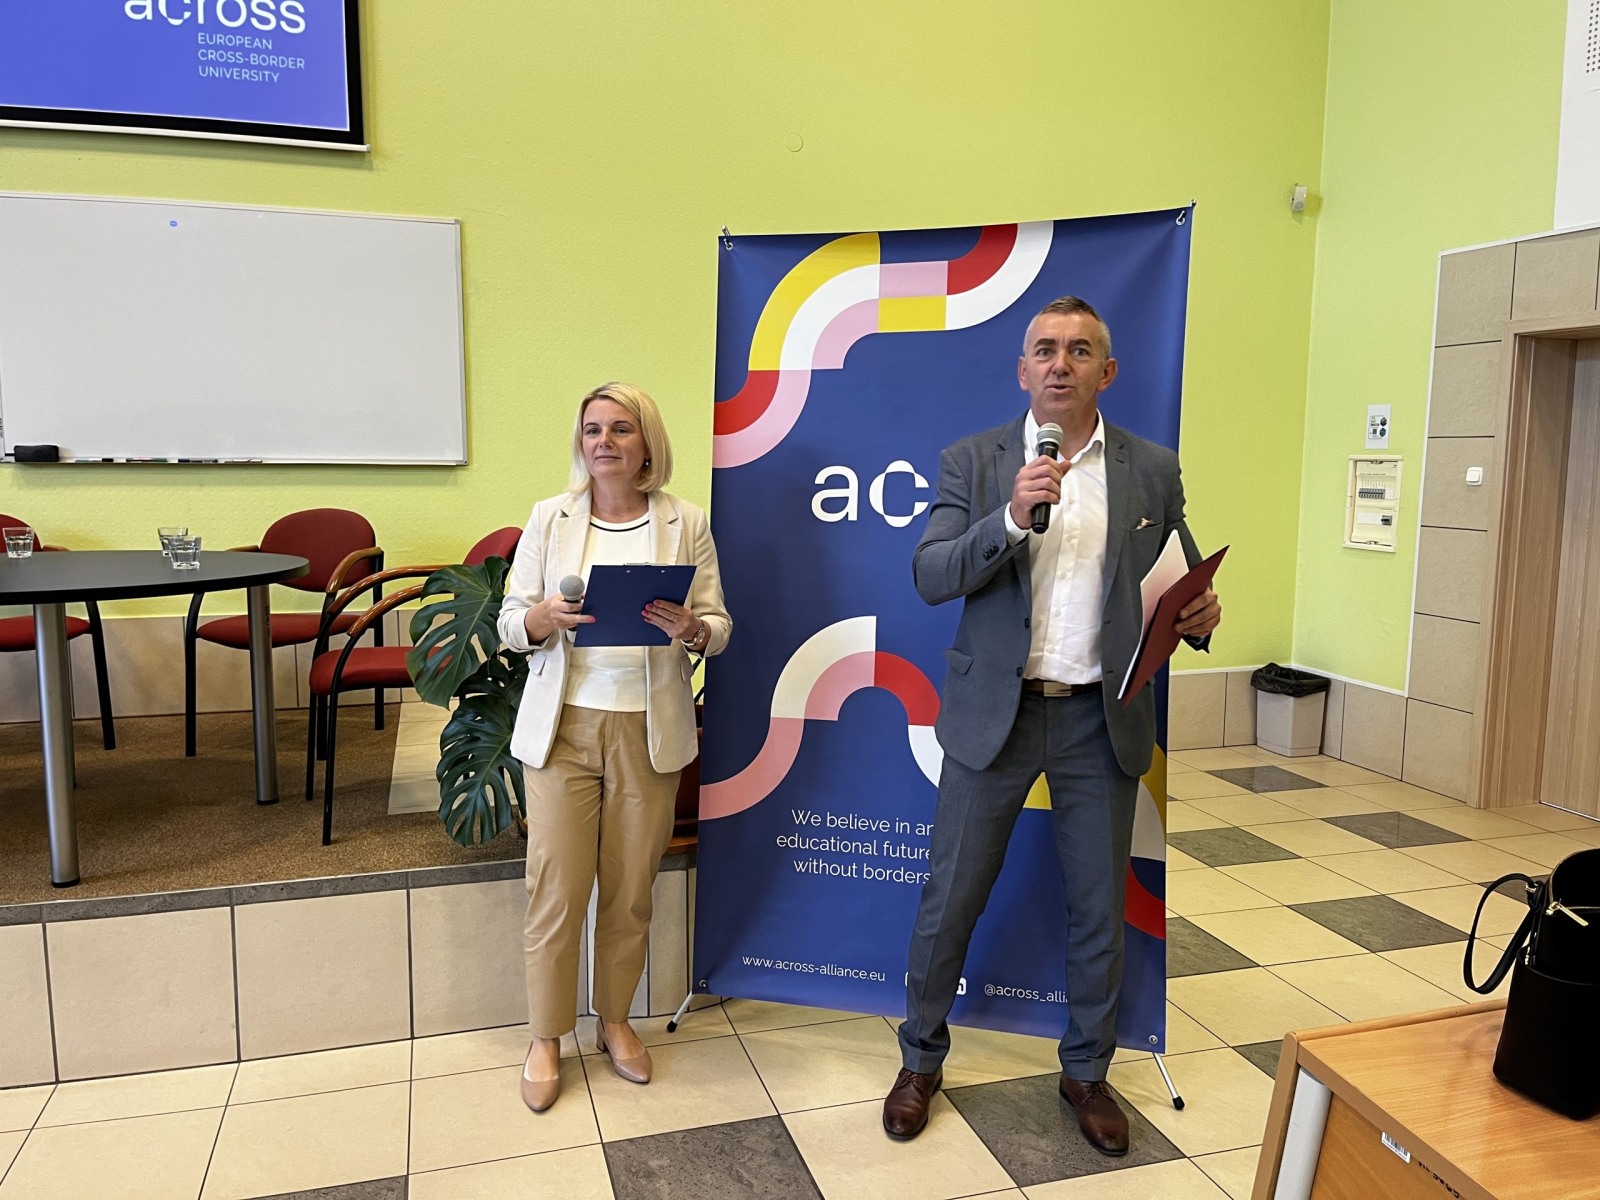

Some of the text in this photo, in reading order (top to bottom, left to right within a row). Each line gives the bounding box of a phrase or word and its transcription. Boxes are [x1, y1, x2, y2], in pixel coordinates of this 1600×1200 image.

[124, 0, 306, 33] across
[197, 32, 272, 50] EUROPEAN
[198, 49, 305, 69] CROSS-BORDER
[198, 65, 280, 83] UNIVERSITY
[791, 809, 821, 826] We
[826, 811, 890, 832] believe
[895, 818, 910, 834] in
[776, 833, 878, 856] educational
[793, 858, 858, 878] without
[742, 956, 886, 982] www.across-alliance.eu
[984, 983, 1067, 1003] @across_alli
